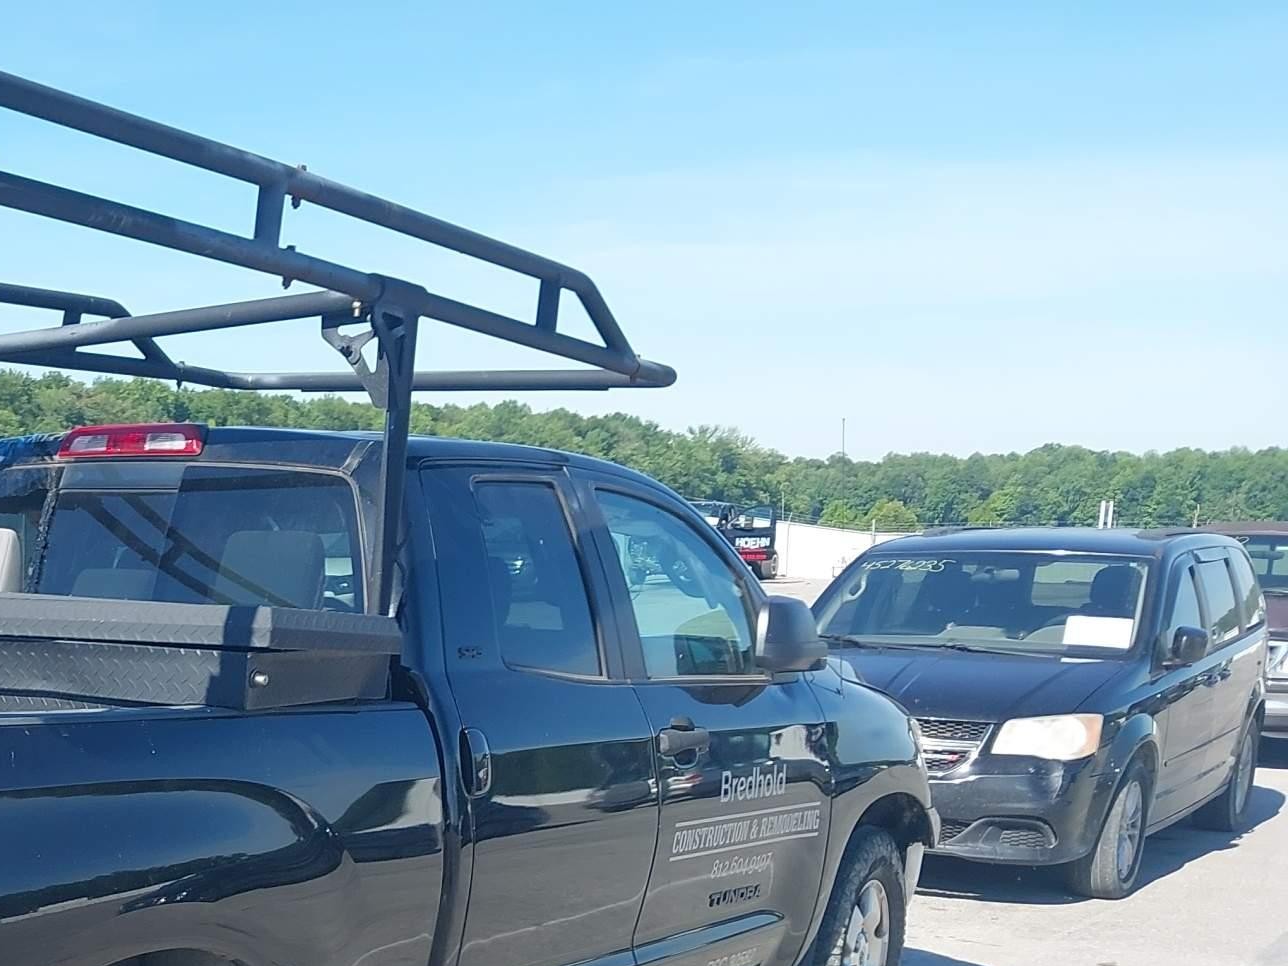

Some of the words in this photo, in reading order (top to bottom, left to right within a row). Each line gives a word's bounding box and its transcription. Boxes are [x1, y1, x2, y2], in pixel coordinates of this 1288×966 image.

[735, 537, 771, 548] HOEHN
[720, 763, 787, 802] Bredhold
[672, 820, 751, 854] CONSTRUCTION
[750, 818, 760, 837] &
[759, 809, 821, 837] REMODELING
[708, 883, 761, 907] TUNDRA
